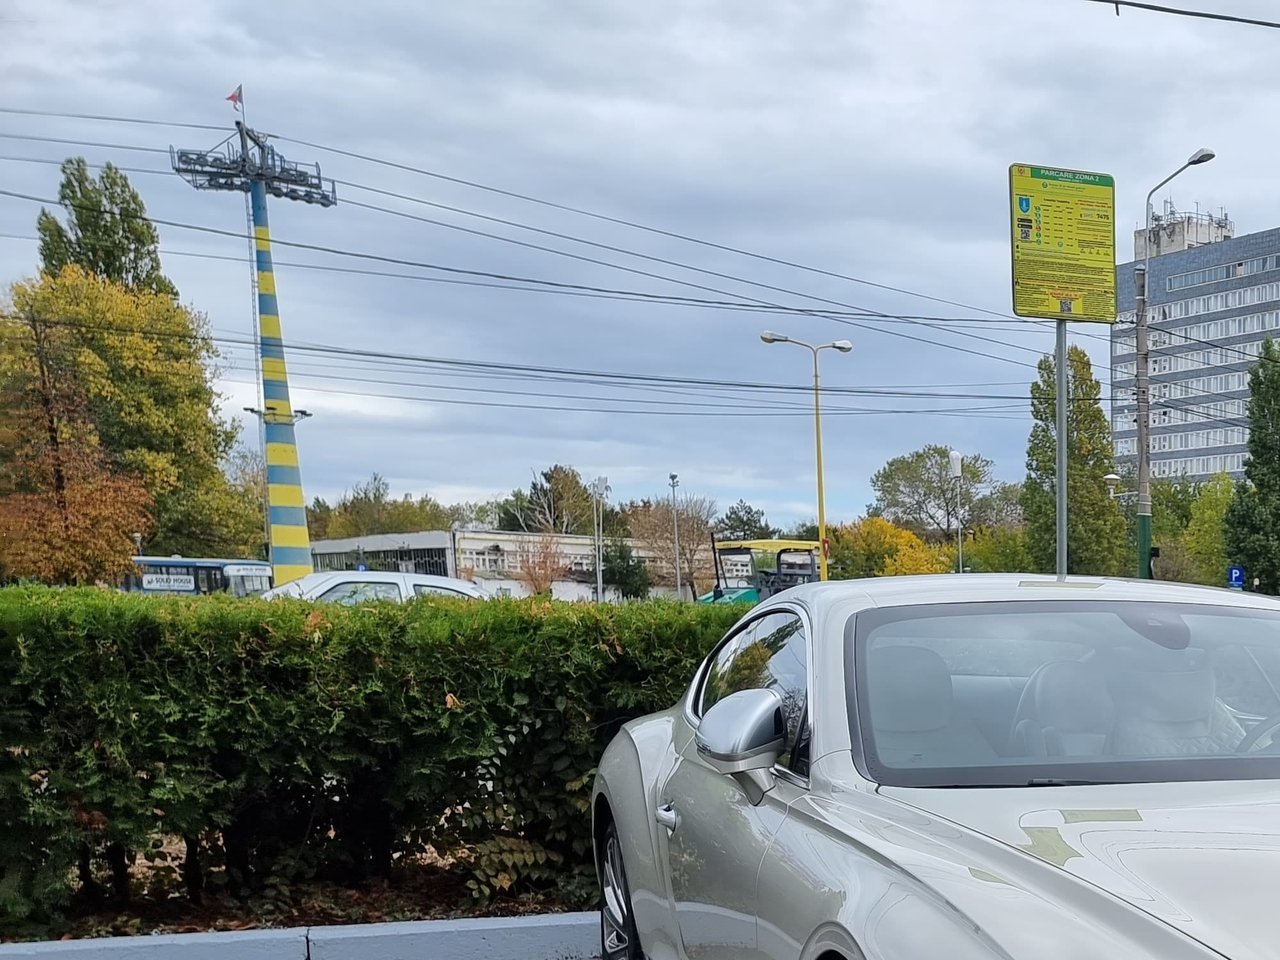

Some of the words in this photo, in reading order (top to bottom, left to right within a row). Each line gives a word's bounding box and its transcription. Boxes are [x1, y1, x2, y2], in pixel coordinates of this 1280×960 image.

[1040, 169, 1074, 179] PARCARE
[1075, 173, 1095, 182] ZONA
[1232, 569, 1240, 582] P
